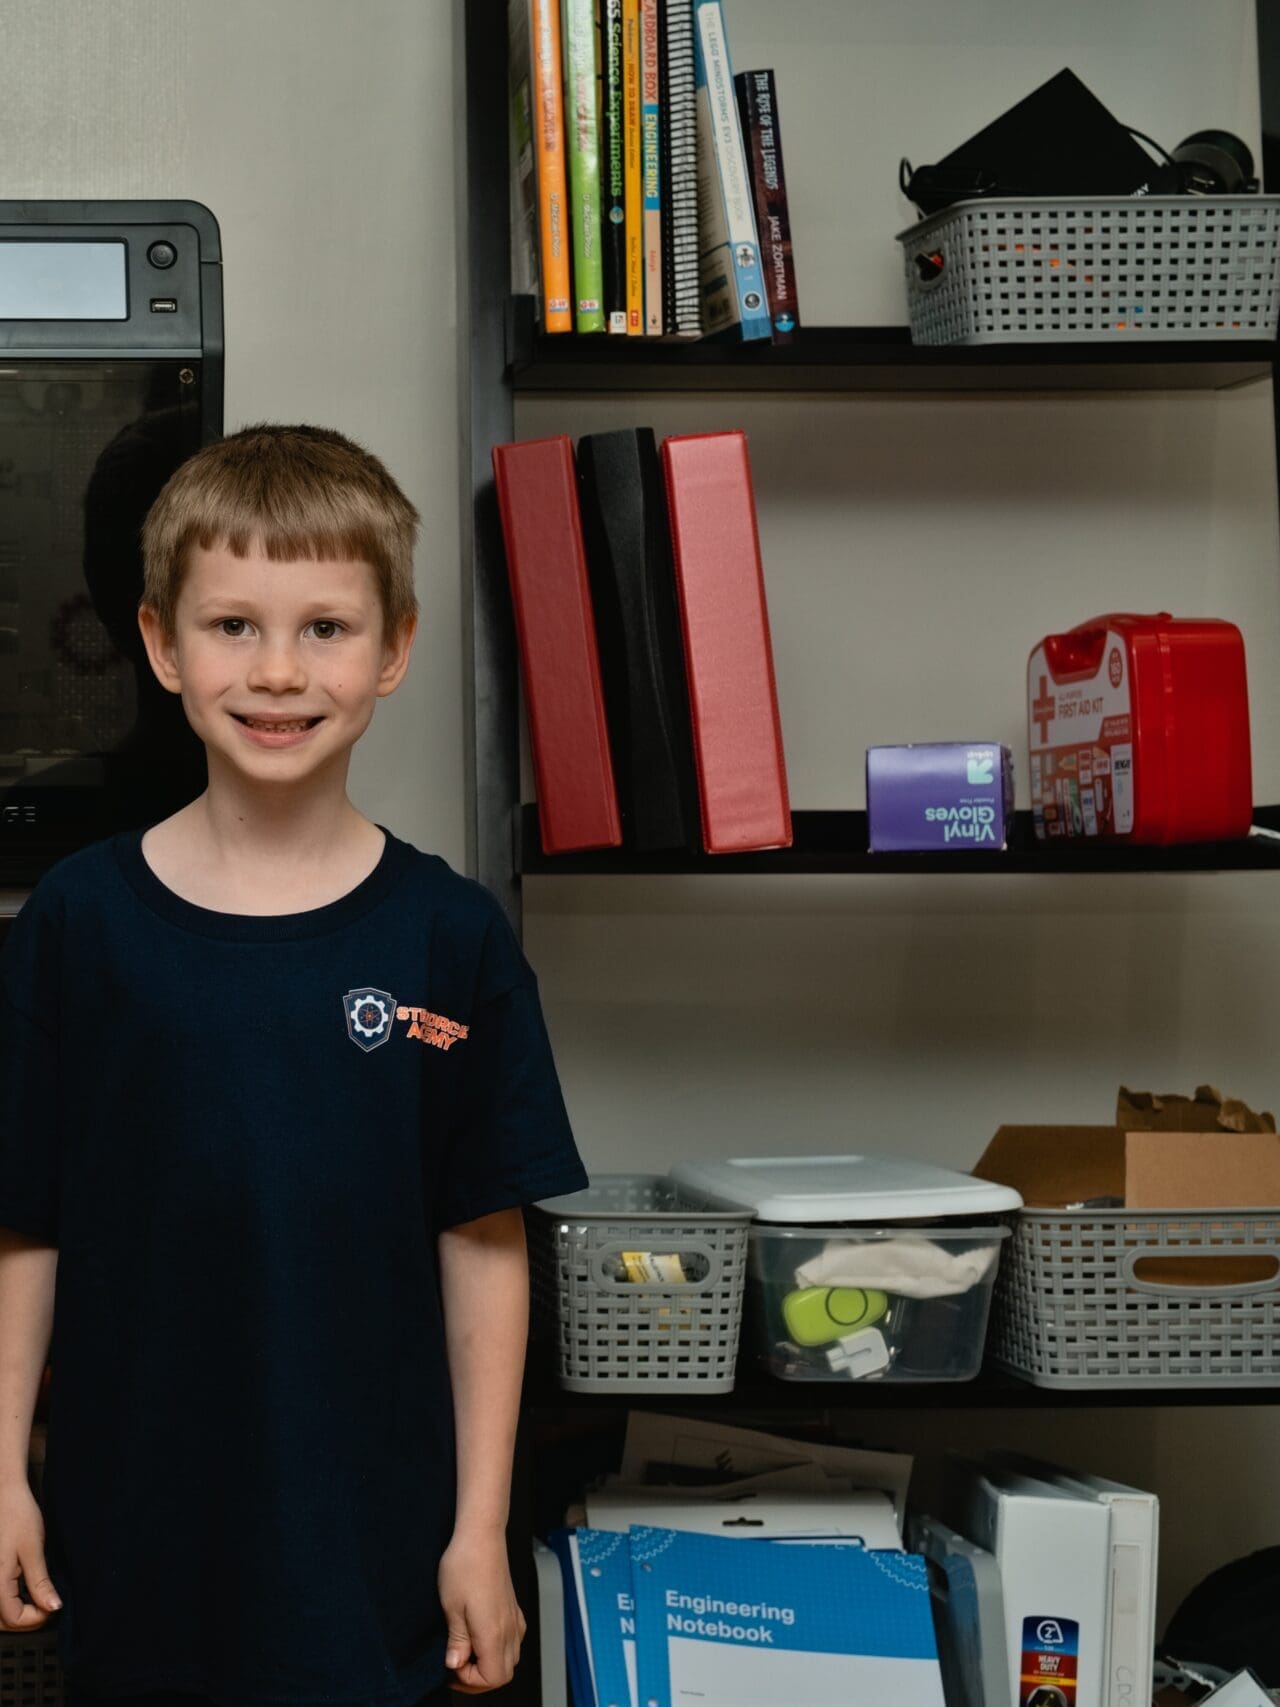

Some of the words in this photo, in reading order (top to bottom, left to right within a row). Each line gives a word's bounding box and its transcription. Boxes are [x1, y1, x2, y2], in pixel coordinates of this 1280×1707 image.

[705, 12, 715, 28] THE
[644, 0, 657, 68] ARDBOARD
[708, 32, 719, 56] LEGO
[610, 23, 621, 85] Science
[644, 72, 657, 99] BOX
[713, 57, 729, 122] MINDSTORMS
[754, 72, 768, 91] THE
[756, 93, 771, 114] RISE
[759, 114, 772, 126] OF
[606, 91, 622, 197] Experiments
[722, 124, 732, 144] EV3
[761, 127, 775, 147] THE
[645, 113, 658, 198] ENGINEERING
[761, 147, 778, 190] LEGENDS
[768, 216, 781, 241] JAKE
[772, 243, 787, 300] ZORTMAN
[1058, 701, 1077, 718] FIRST
[1079, 699, 1091, 715] AID
[1092, 696, 1104, 713] KIT
[925, 806, 995, 823] Gloves
[944, 821, 995, 842] Vinyl
[665, 1589, 795, 1625] Engineering
[666, 1613, 773, 1643] Notebook
[1038, 1655, 1060, 1664] HEAVY
[1040, 1662, 1059, 1672] DUTY
